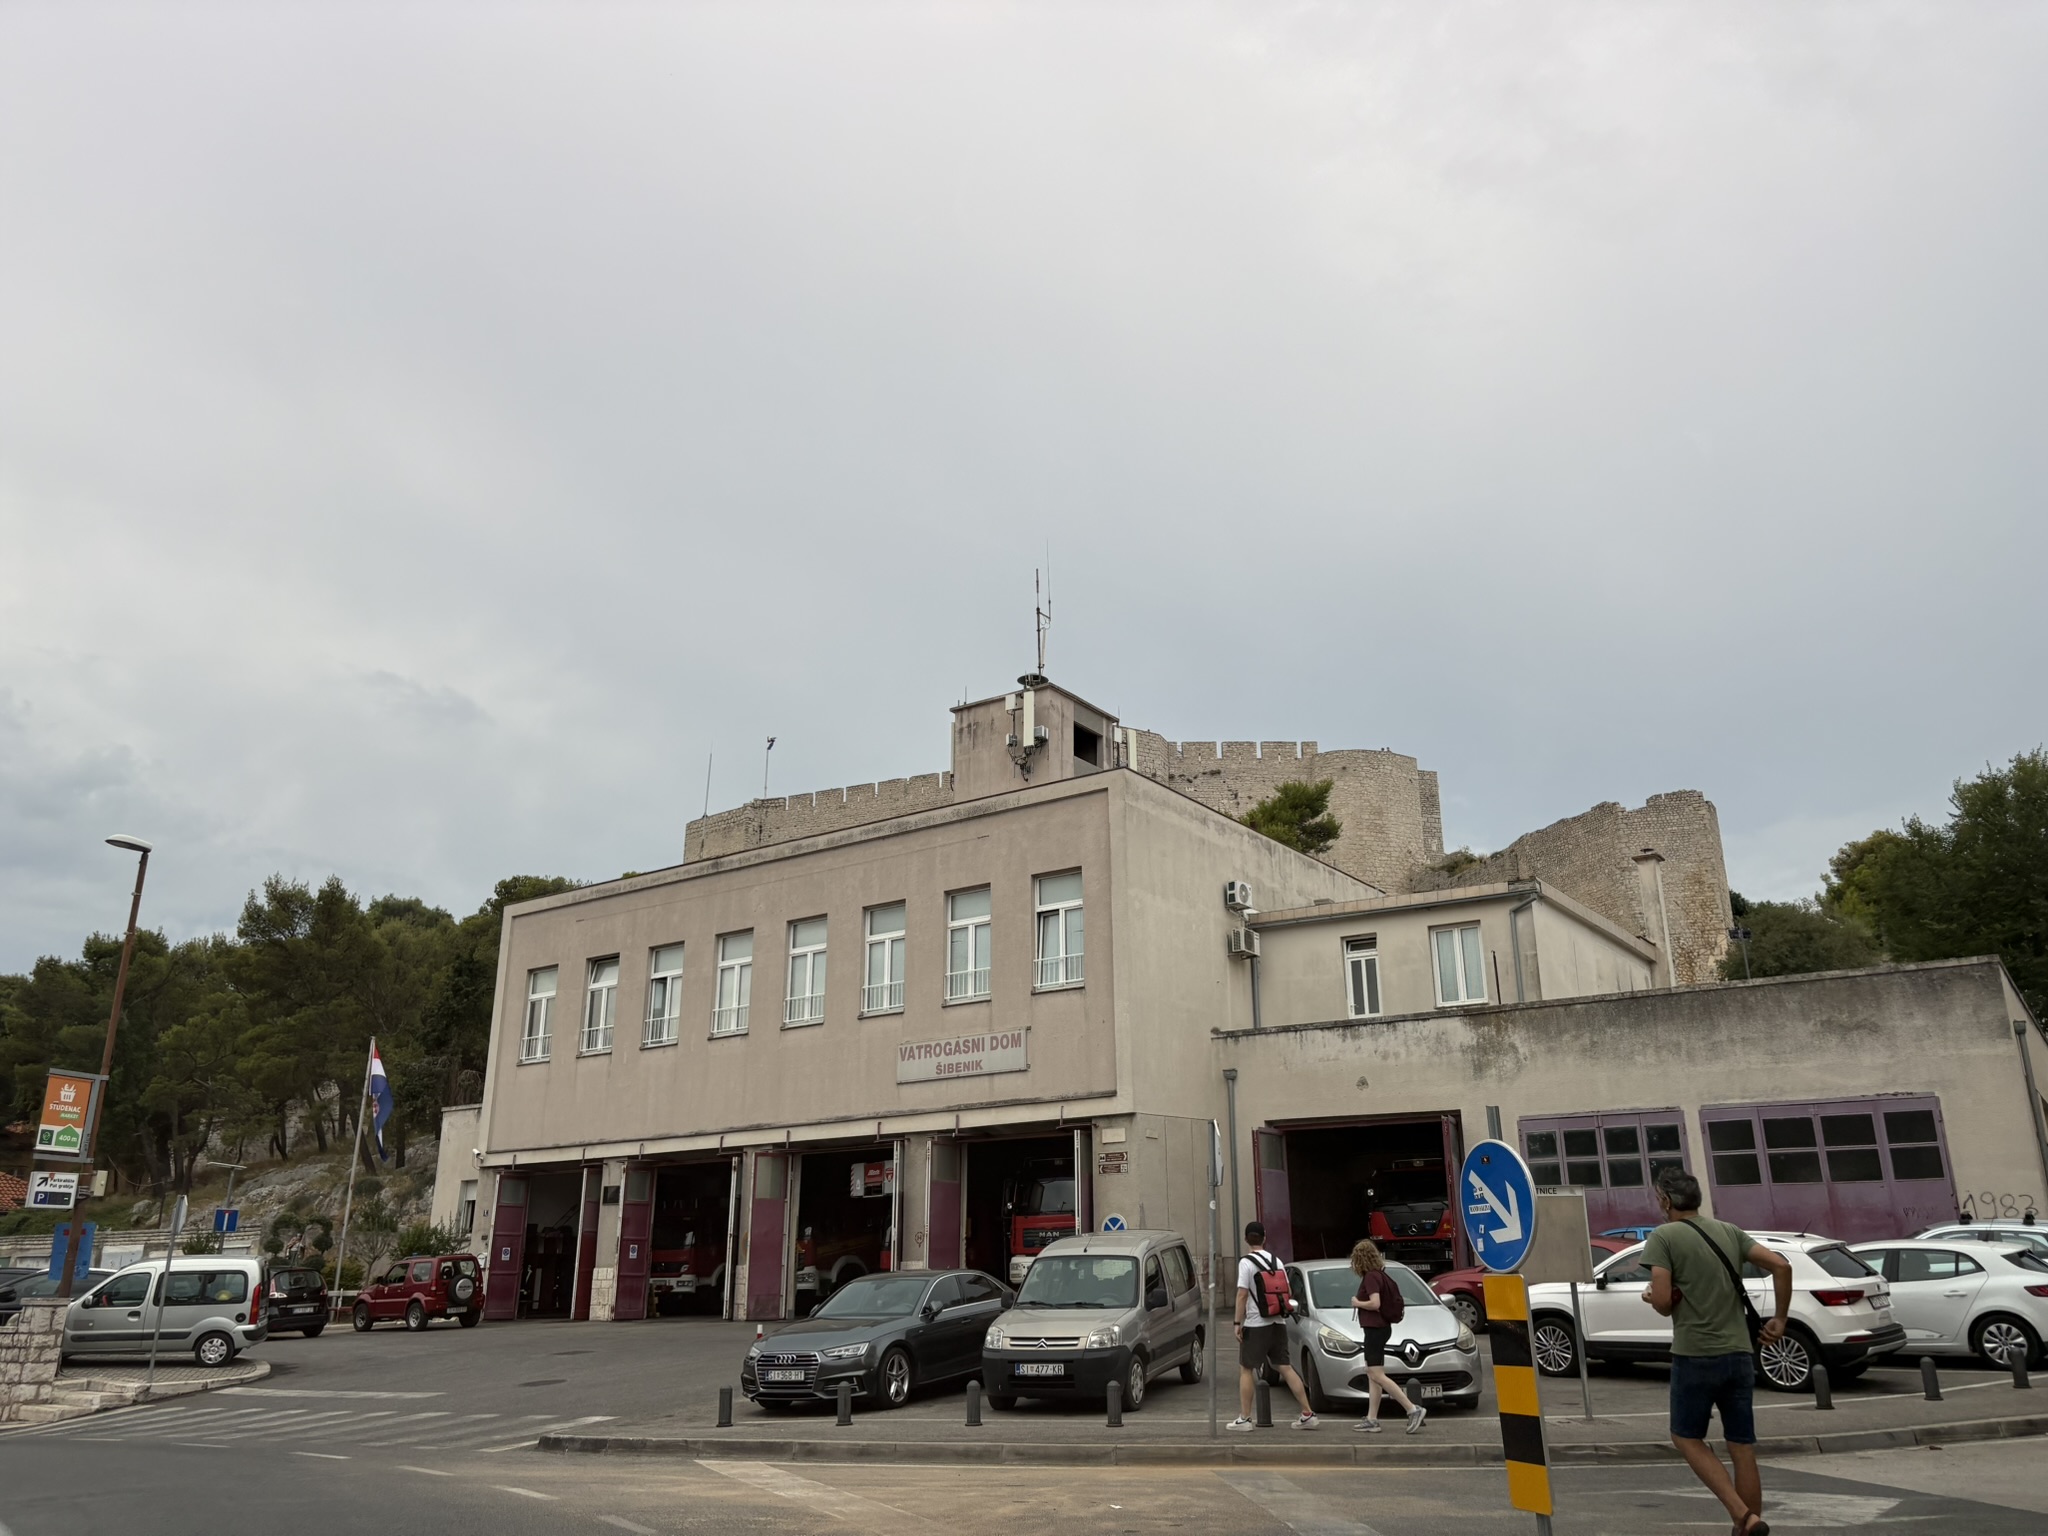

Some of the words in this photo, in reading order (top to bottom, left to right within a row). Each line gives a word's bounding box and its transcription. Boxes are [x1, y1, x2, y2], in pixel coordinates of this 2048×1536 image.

[899, 1037, 985, 1061] VATROGASNI
[990, 1032, 1022, 1051] DOM
[935, 1059, 983, 1075] ŠIBENIK
[49, 1103, 82, 1113] STUDENAC
[59, 1134, 71, 1142] 400
[37, 1193, 45, 1203] P
[1963, 1191, 2039, 1219] 1983
[1020, 1364, 1029, 1374] SI
